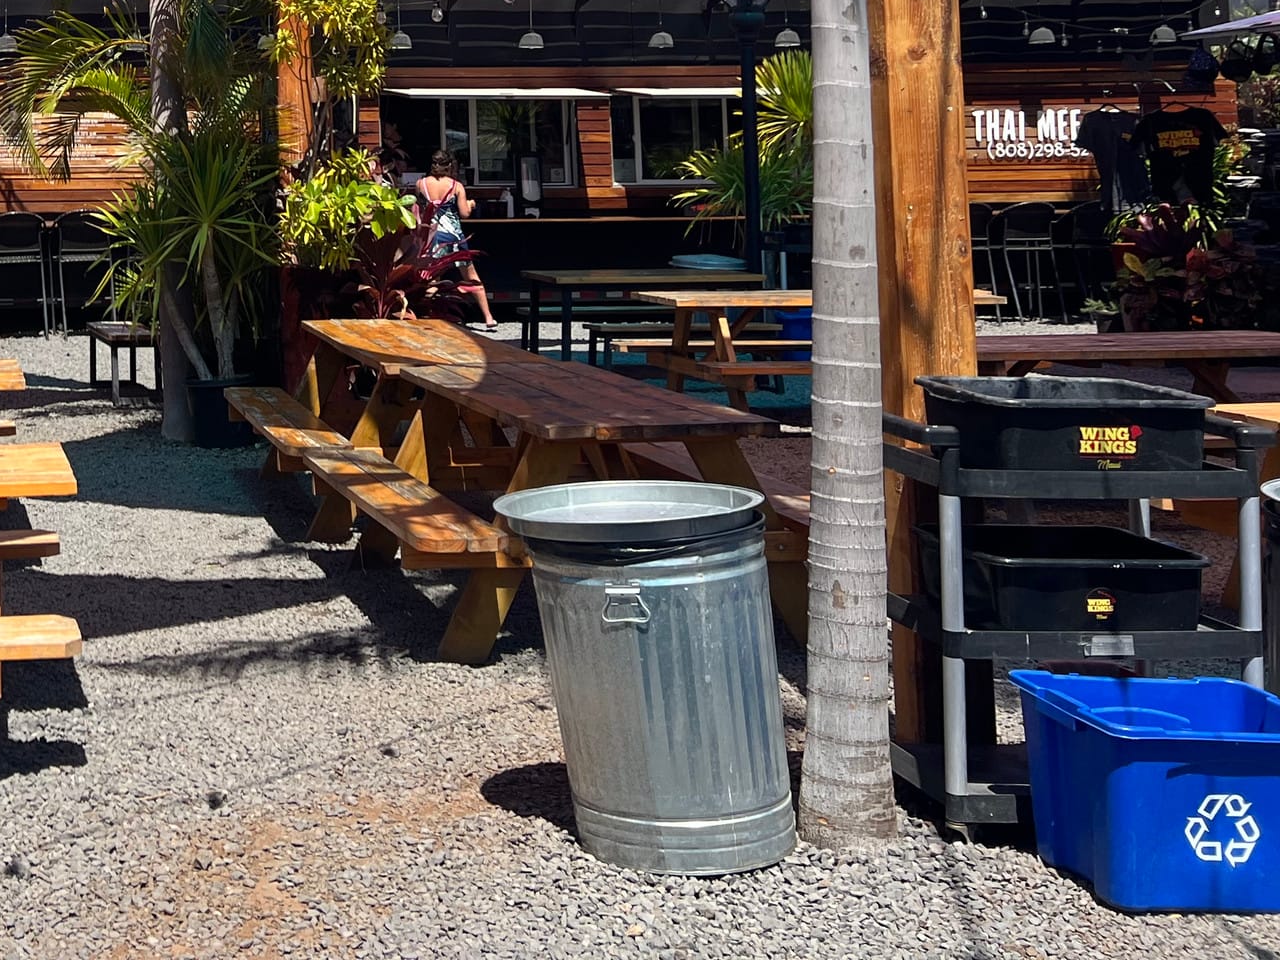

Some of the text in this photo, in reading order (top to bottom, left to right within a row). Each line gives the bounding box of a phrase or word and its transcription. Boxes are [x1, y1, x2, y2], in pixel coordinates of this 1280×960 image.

[972, 108, 1025, 142] THAI
[987, 141, 1090, 159] (808)298-52
[1080, 426, 1130, 441] WING
[1080, 440, 1137, 454] KINGS
